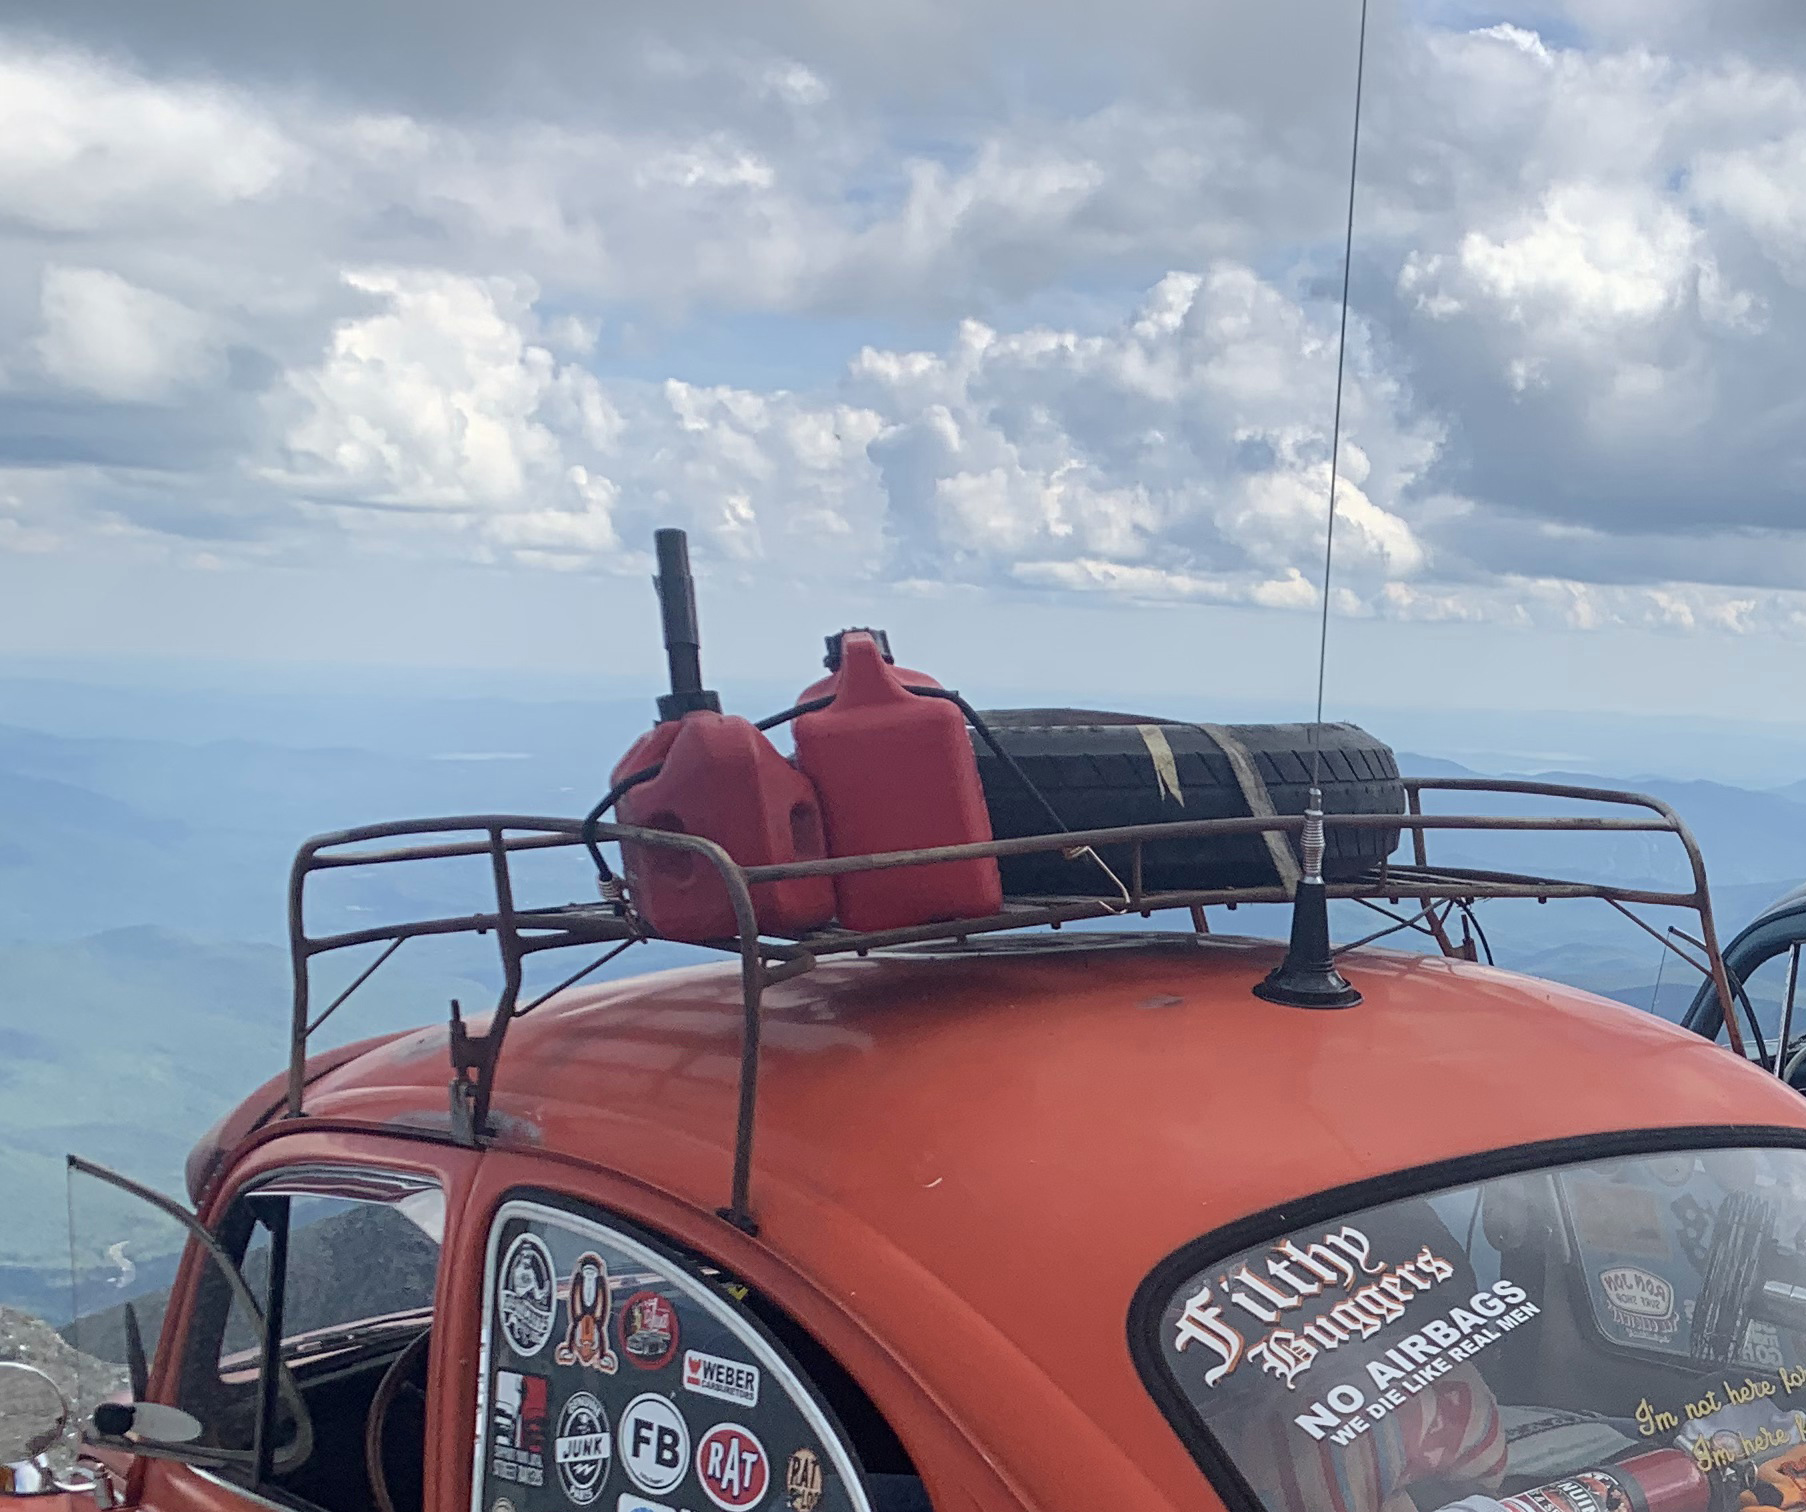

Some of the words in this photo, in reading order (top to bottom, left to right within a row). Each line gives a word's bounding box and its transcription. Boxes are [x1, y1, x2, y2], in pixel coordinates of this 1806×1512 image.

[1175, 1226, 1389, 1388] Filthy
[1247, 1246, 1454, 1389] Buggers
[702, 1360, 755, 1392] WEBER
[1295, 1384, 1365, 1440] NO
[1366, 1280, 1527, 1390] AIRBAGS
[1330, 1415, 1370, 1446] WE
[1366, 1390, 1406, 1422] DIE
[1406, 1358, 1453, 1394] LIKE
[1448, 1327, 1501, 1363] REAL
[1498, 1301, 1541, 1331] MEN
[1635, 1398, 1678, 1435] I'm
[1685, 1391, 1722, 1419] not
[1724, 1378, 1776, 1404] here
[563, 1438, 603, 1459] JUNK
[632, 1417, 680, 1468] FB
[707, 1437, 758, 1498] RAT
[1692, 1434, 1736, 1471] I'm
[1742, 1427, 1790, 1451] here
[788, 1455, 819, 1489] RAT
